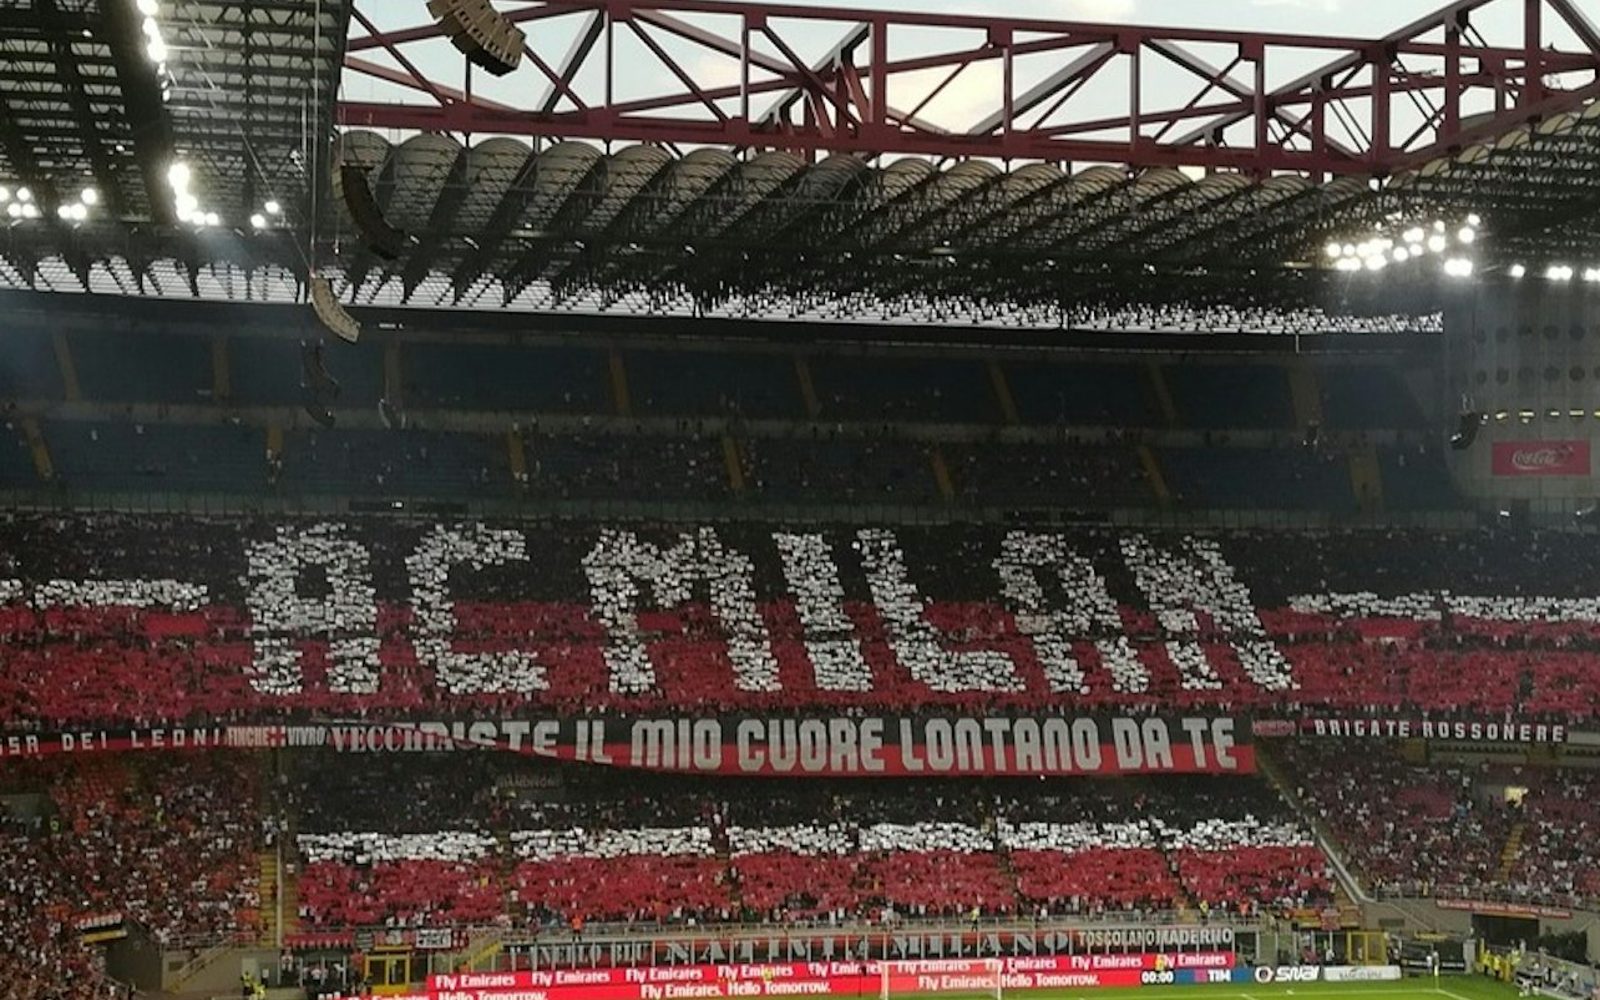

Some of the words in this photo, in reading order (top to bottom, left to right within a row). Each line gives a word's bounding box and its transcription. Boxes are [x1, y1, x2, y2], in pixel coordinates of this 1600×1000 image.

[581, 527, 1300, 693] MILAN
[1314, 719, 1410, 738] BRIGATE
[1422, 720, 1564, 743] ROSSONERE
[0, 735, 40, 755] SA
[62, 731, 107, 752] DEI
[131, 728, 219, 748] LEONI
[575, 719, 613, 764] IL
[631, 719, 722, 770] MIO
[736, 718, 885, 772] CUORE
[900, 718, 1101, 772] LONTANO
[1112, 718, 1173, 769] DA
[1182, 718, 1237, 770] TE
[1007, 957, 1057, 972] Emirates
[1071, 956, 1091, 971] Fly
[1093, 955, 1142, 968] Emirates
[1177, 952, 1227, 966] Emirates
[532, 971, 553, 986] Fly
[556, 970, 611, 984] Emirates
[626, 968, 647, 984] Fly
[650, 966, 703, 981] Emirates
[718, 964, 738, 981] Fly
[1207, 969, 1232, 982] TIM
[435, 974, 456, 990] Fly
[461, 974, 515, 988] Emirates
[641, 984, 662, 999] Fly
[728, 981, 760, 996] Hello
[918, 975, 939, 991] Fly
[1001, 973, 1032, 988] Hello
